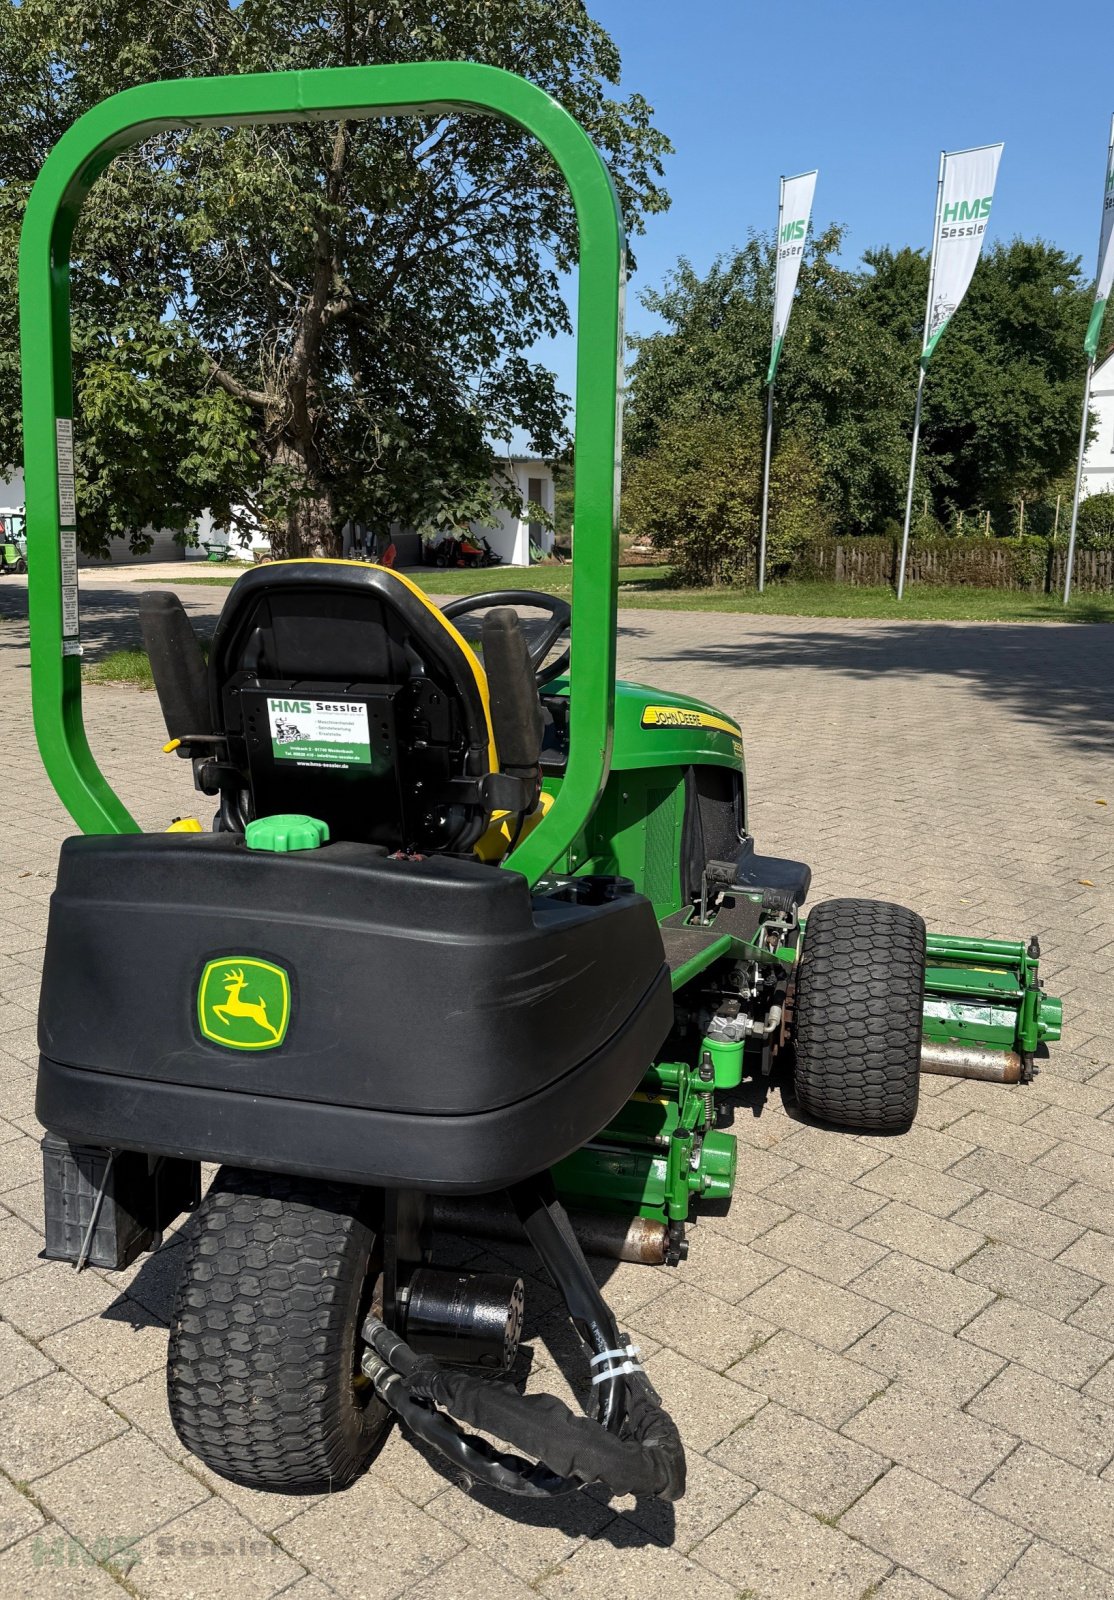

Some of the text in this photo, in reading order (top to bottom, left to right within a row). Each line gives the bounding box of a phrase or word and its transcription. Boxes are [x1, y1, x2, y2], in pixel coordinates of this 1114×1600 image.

[943, 196, 993, 223] HMS
[270, 700, 311, 714] HMS
[316, 702, 364, 713] Sessler
[655, 710, 703, 727] JOHN DEERE
